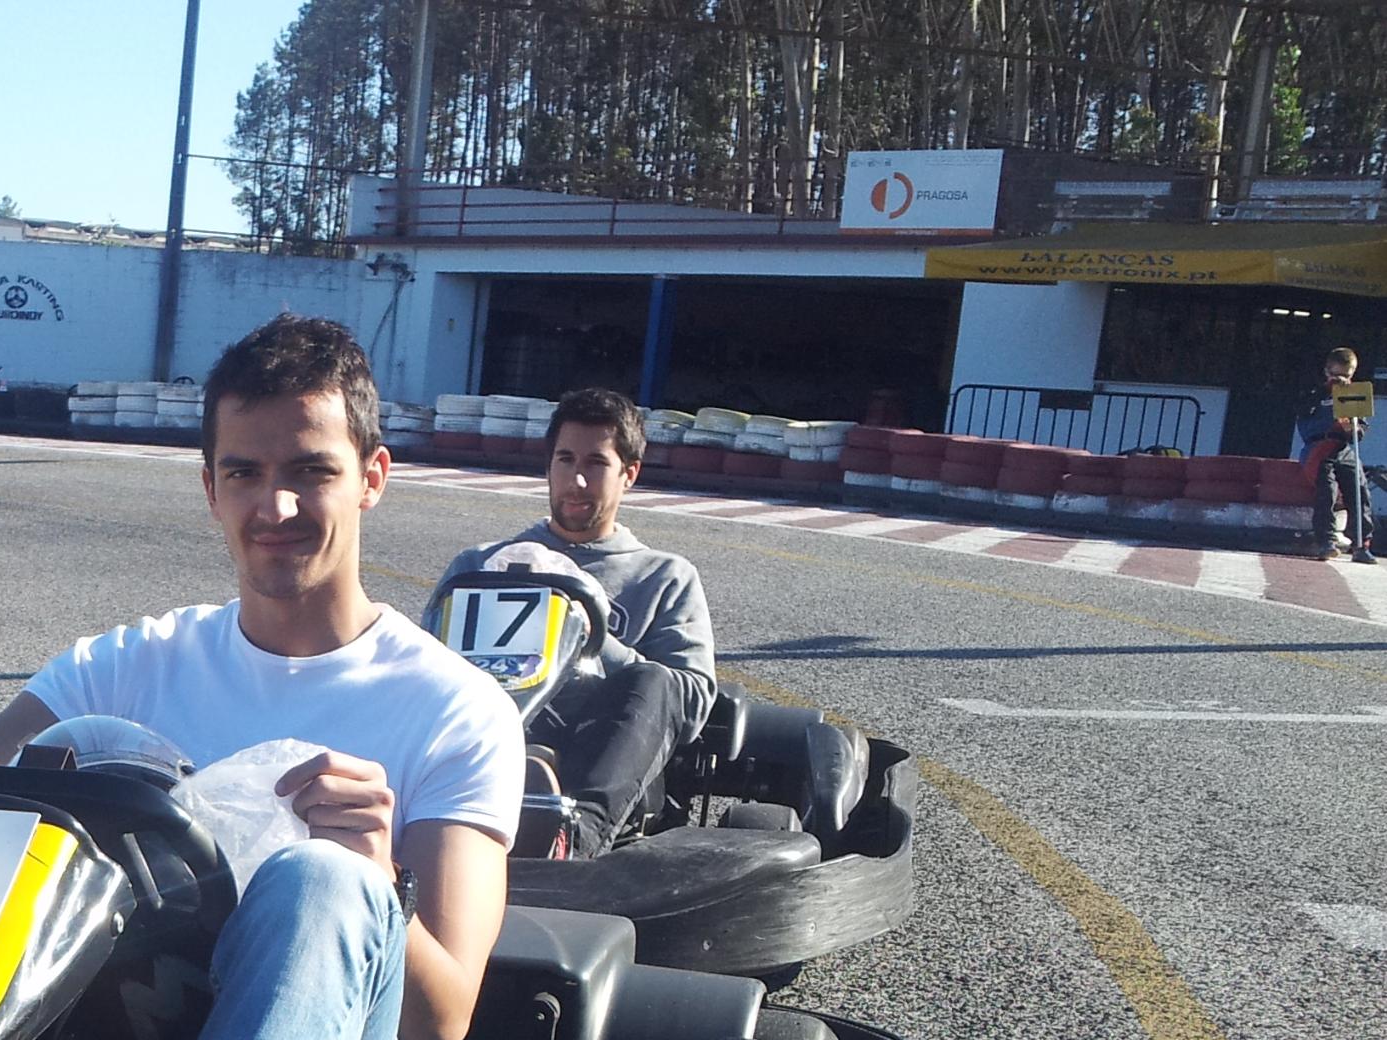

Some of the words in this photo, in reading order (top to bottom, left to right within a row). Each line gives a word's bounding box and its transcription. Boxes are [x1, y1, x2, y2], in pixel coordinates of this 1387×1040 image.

[916, 190, 969, 201] PRAGOSA
[978, 264, 1219, 282] www.pestronix.pt
[17, 274, 65, 321] KARTING
[460, 592, 542, 651] 17
